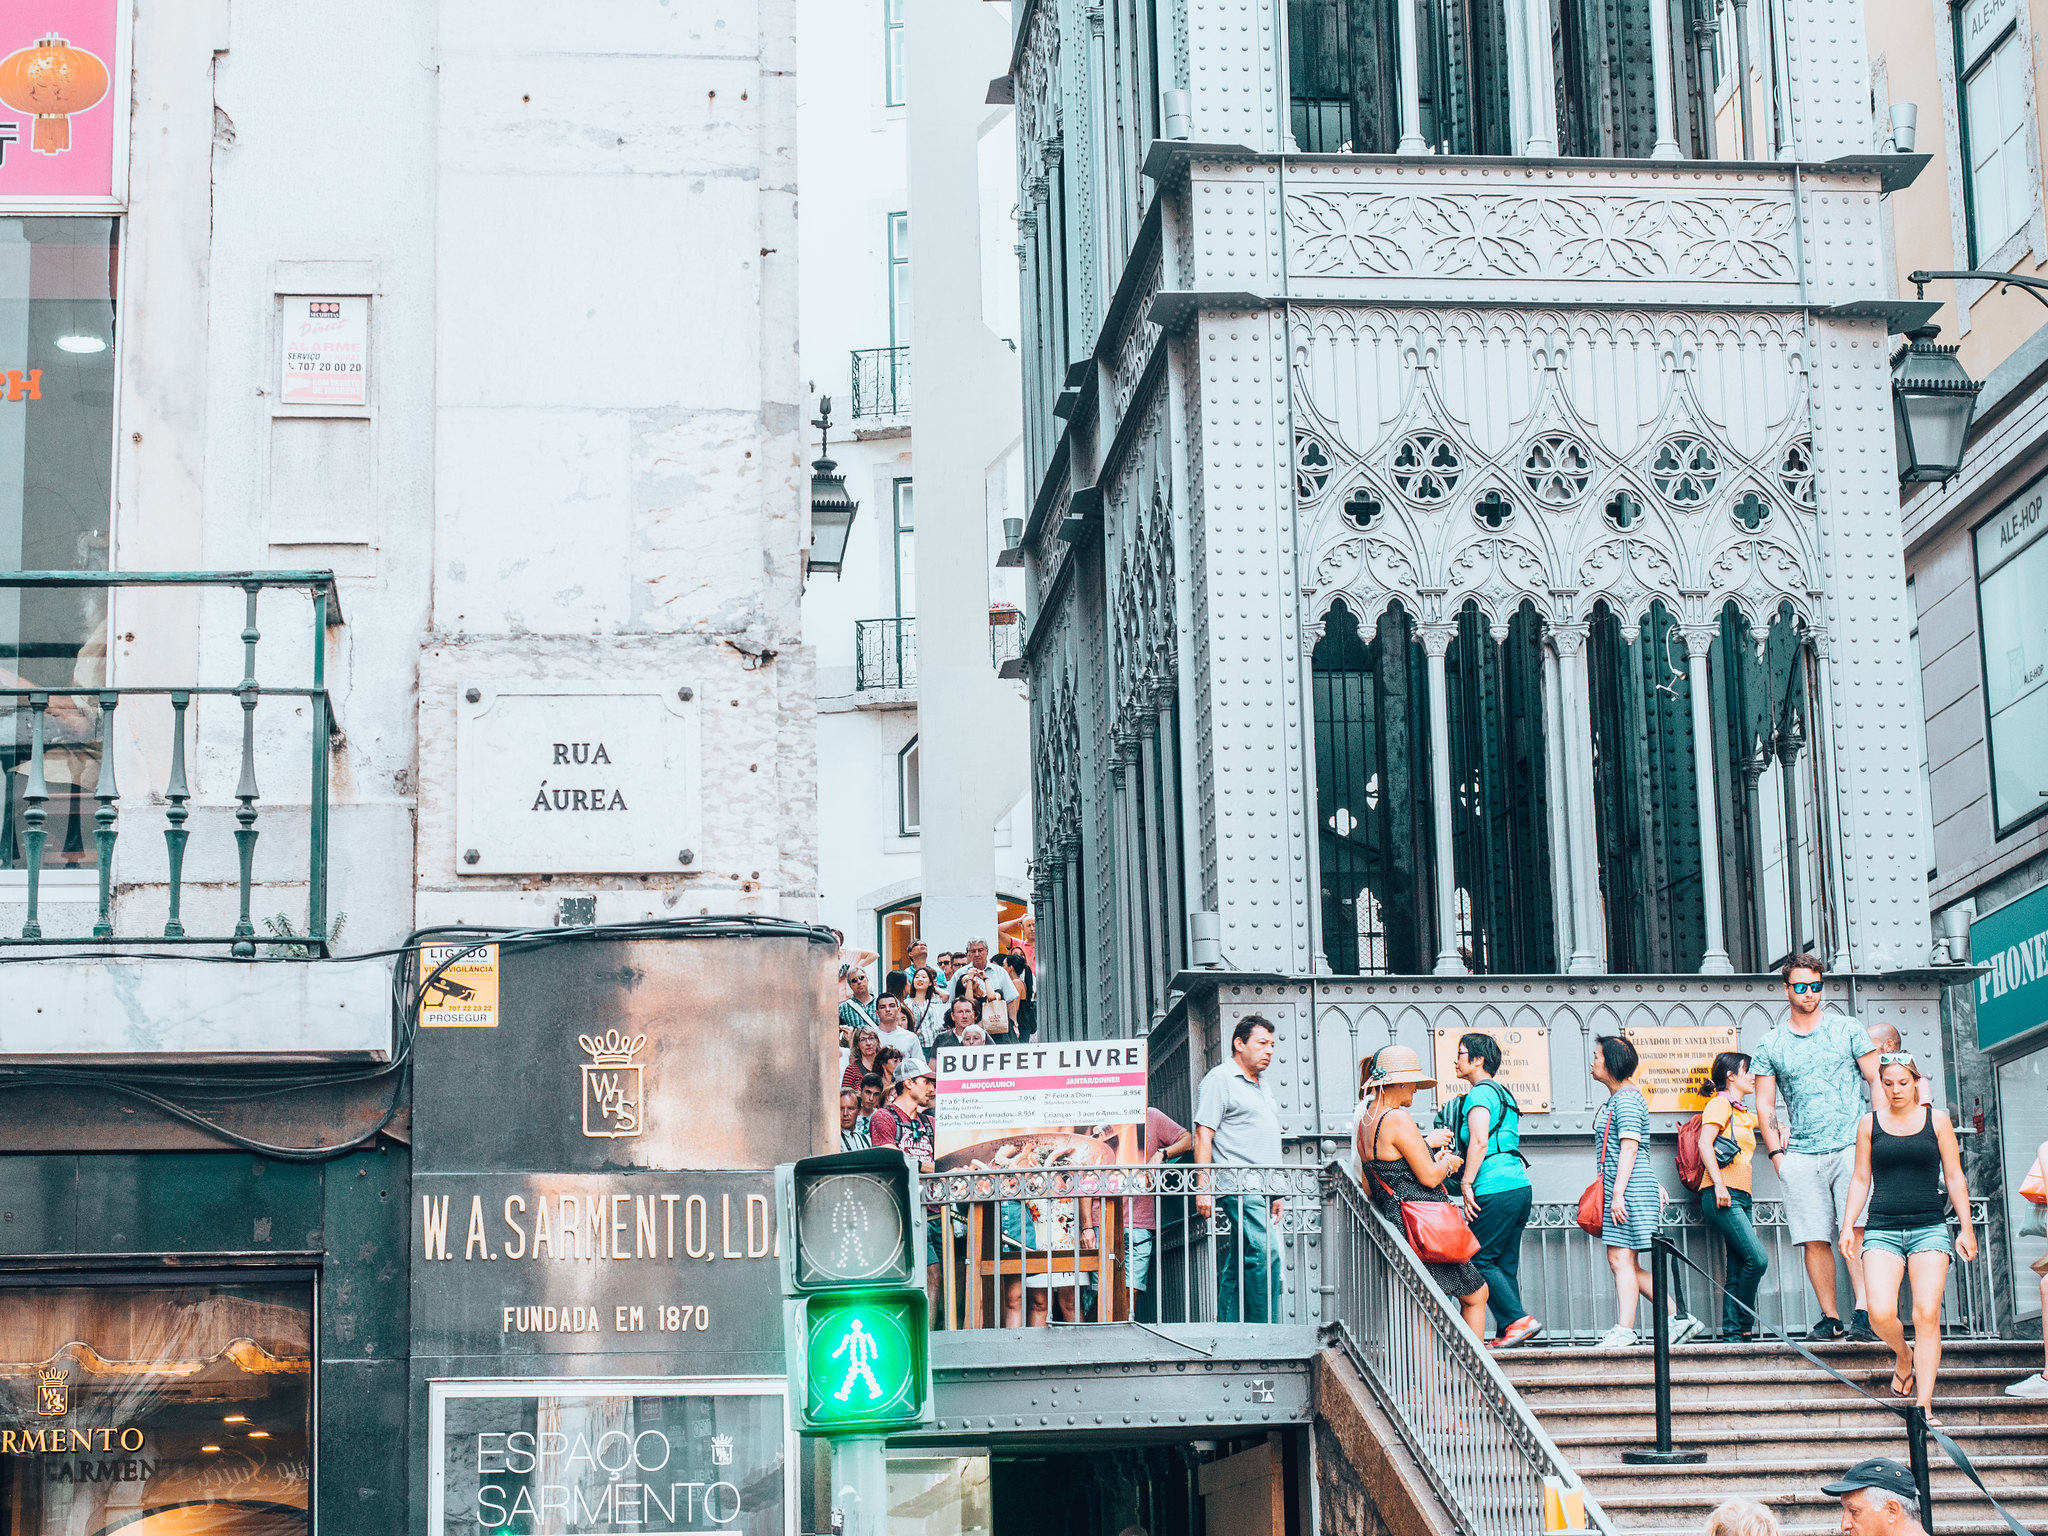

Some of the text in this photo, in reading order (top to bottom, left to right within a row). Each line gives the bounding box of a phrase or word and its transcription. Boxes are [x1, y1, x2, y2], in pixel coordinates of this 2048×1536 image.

[288, 342, 361, 352] ALARME
[288, 352, 320, 360] SERVIÇO
[298, 362, 362, 372] 707 20 00 20
[2001, 495, 2042, 548] ALE-HOP
[552, 742, 612, 765] RUA
[531, 780, 628, 811] ÁUREA
[430, 948, 488, 958] LIGDO
[430, 1014, 487, 1022] PROSEGUR
[1632, 1038, 1670, 1046] ELEVADOR
[1684, 1037, 1708, 1045] SANTA
[1710, 1037, 1730, 1045] JUSTA
[942, 1048, 1139, 1073] BUFFET LIVRE
[961, 1080, 1016, 1090] ALMOÇO/LUNCH
[1066, 1076, 1121, 1085] JANTAR/DINNER
[1506, 1083, 1541, 1093] ACIONAL
[422, 1194, 453, 1261] W.
[465, 1194, 498, 1261] A.
[503, 1305, 710, 1333] FUNDADA EM 1870
[477, 1430, 670, 1481] ESPAÇO
[476, 1481, 742, 1528] SARMENTO
